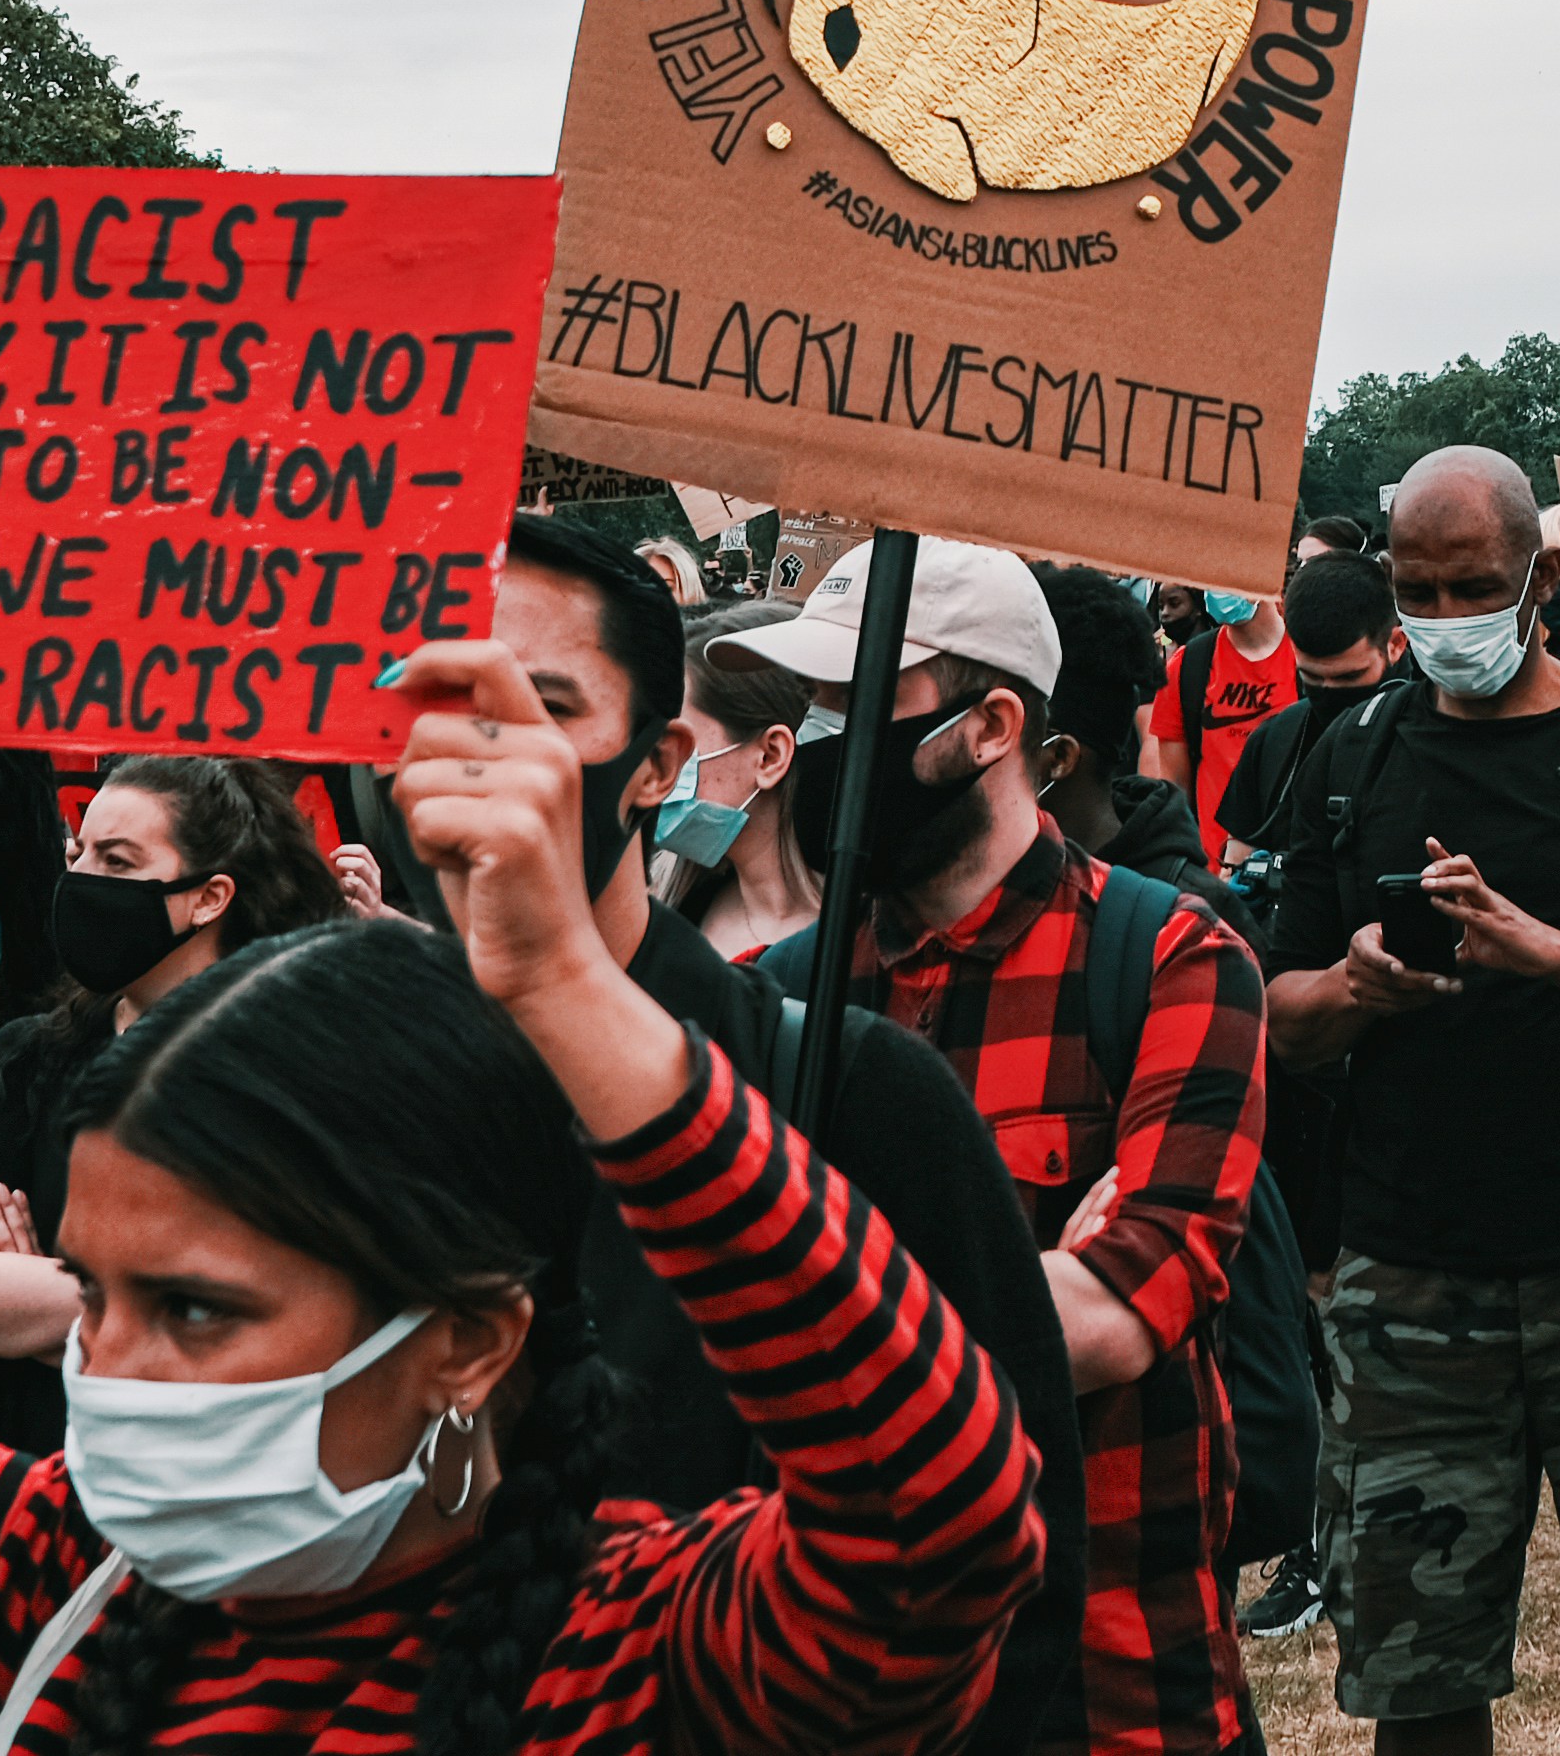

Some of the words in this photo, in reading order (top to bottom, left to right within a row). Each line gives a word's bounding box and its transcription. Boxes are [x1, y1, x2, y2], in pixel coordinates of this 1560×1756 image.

[34, 320, 152, 405] IT
[159, 320, 267, 413] IS
[293, 329, 513, 416] NOT
[548, 274, 1265, 502] #BLACKLIVESMATTER
[110, 426, 194, 505] BE
[211, 438, 465, 530] NON-
[139, 537, 363, 629] MUST
[382, 551, 486, 640] BE
[1218, 682, 1278, 709] NIKE
